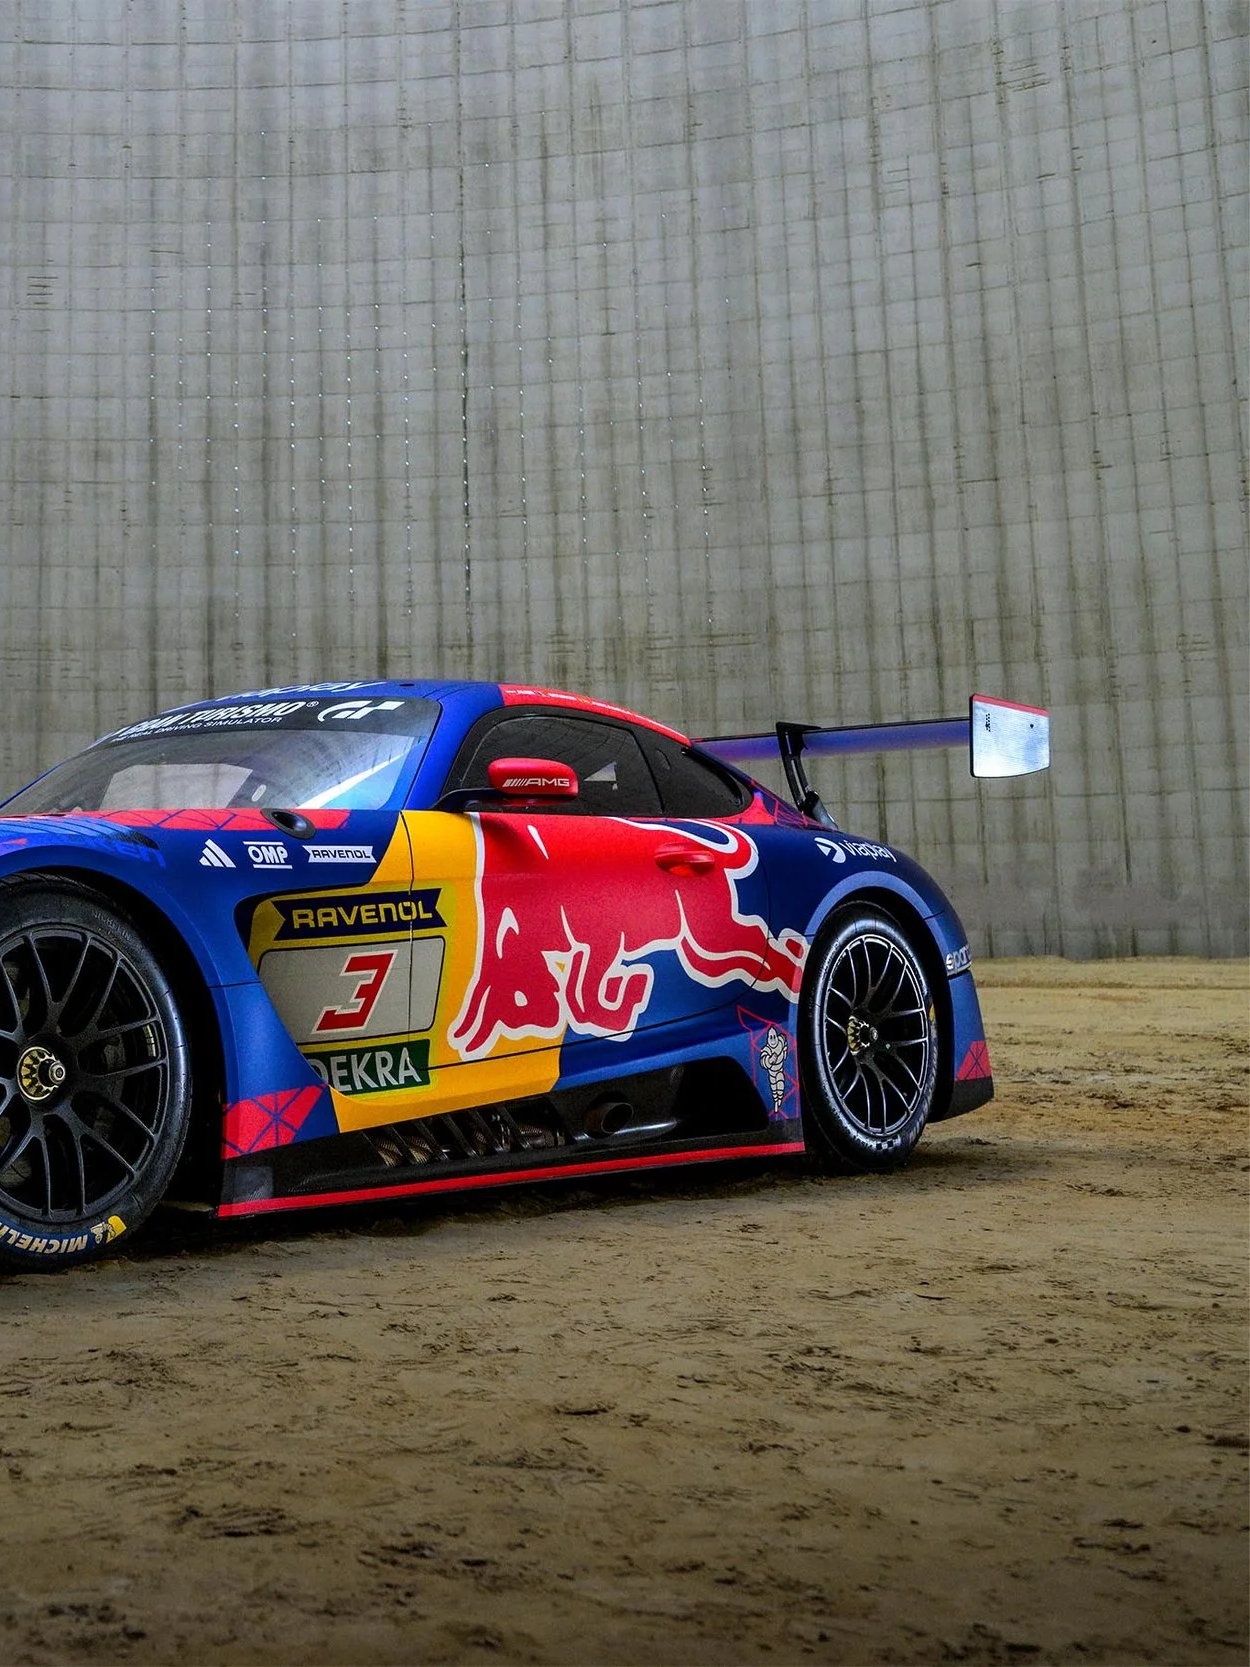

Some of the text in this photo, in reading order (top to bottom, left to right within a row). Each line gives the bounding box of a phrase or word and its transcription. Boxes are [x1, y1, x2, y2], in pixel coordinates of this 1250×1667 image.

[178, 701, 307, 725] TURISMO
[203, 717, 282, 728] SIMULATOR
[525, 777, 570, 788] AMG
[247, 845, 289, 864] OMP
[311, 849, 371, 859] RAVENOL
[291, 900, 433, 929] RAVENOL
[312, 950, 398, 1034] 3
